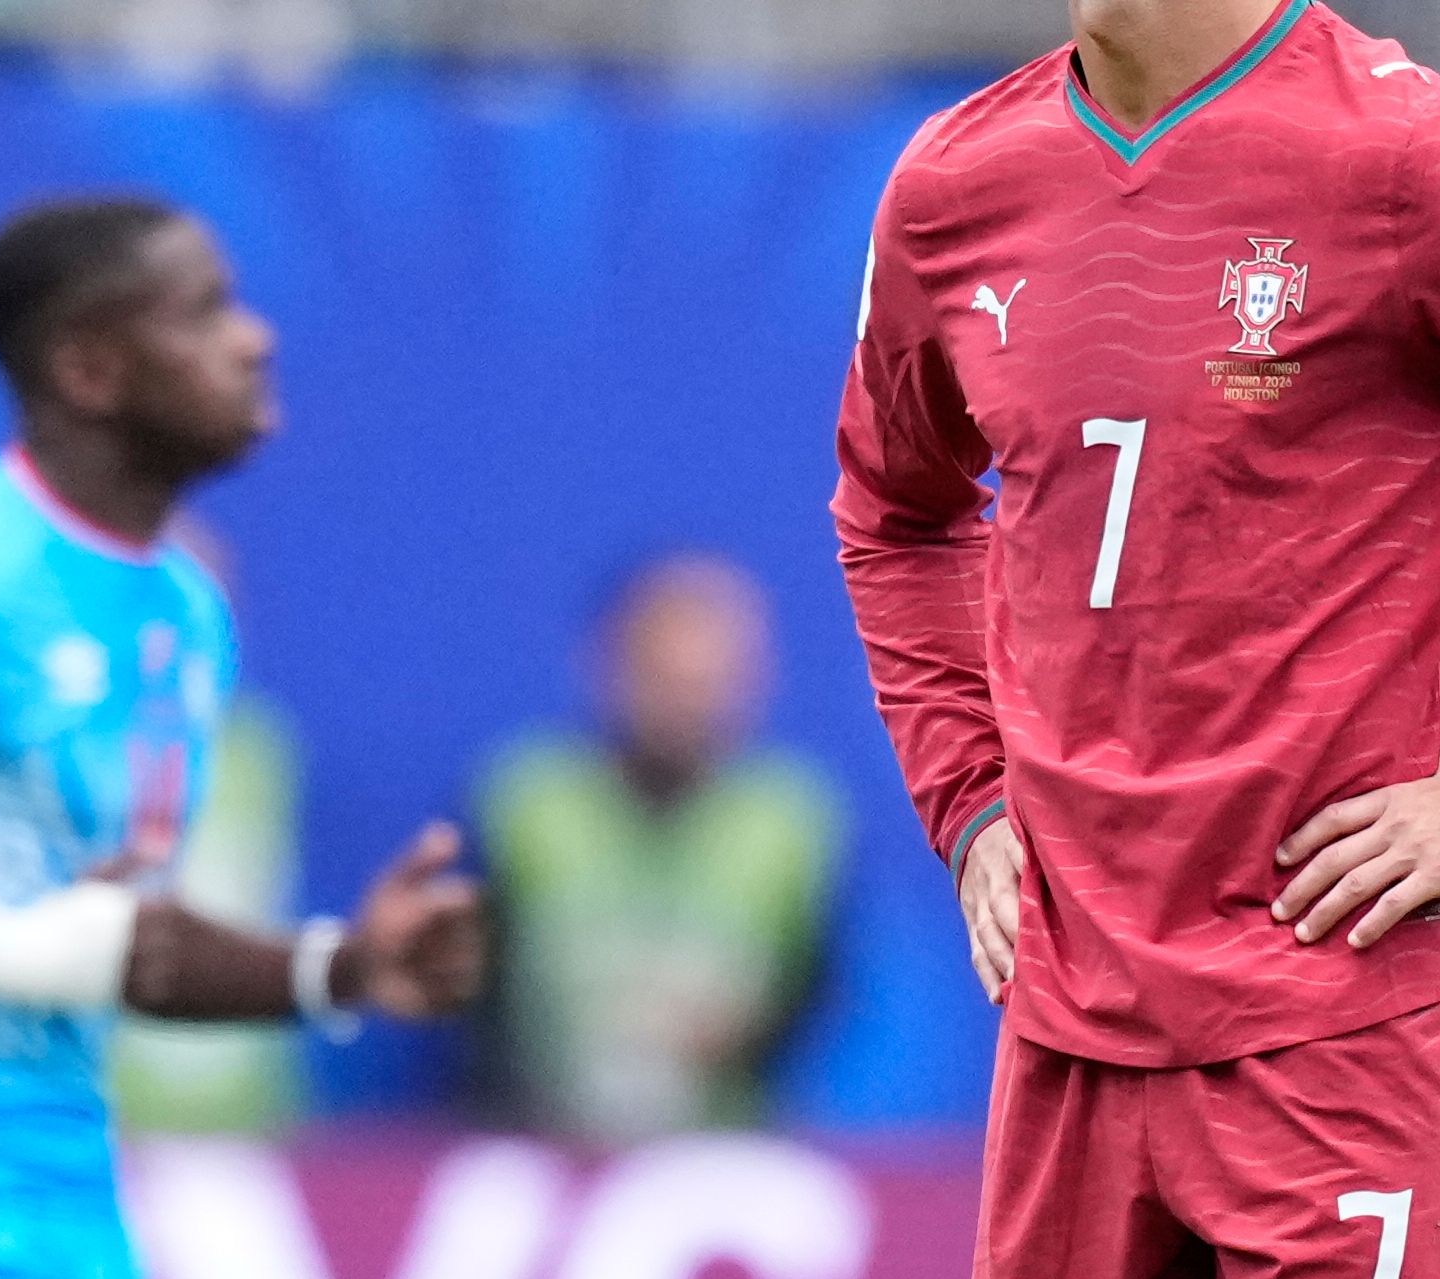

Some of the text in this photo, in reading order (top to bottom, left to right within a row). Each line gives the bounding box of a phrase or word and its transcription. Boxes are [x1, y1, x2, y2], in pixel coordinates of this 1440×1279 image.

[1211, 375, 1293, 388] 17 JUNHO 2026
[1223, 387, 1279, 401] HOUSTON
[1082, 418, 1147, 609] 7
